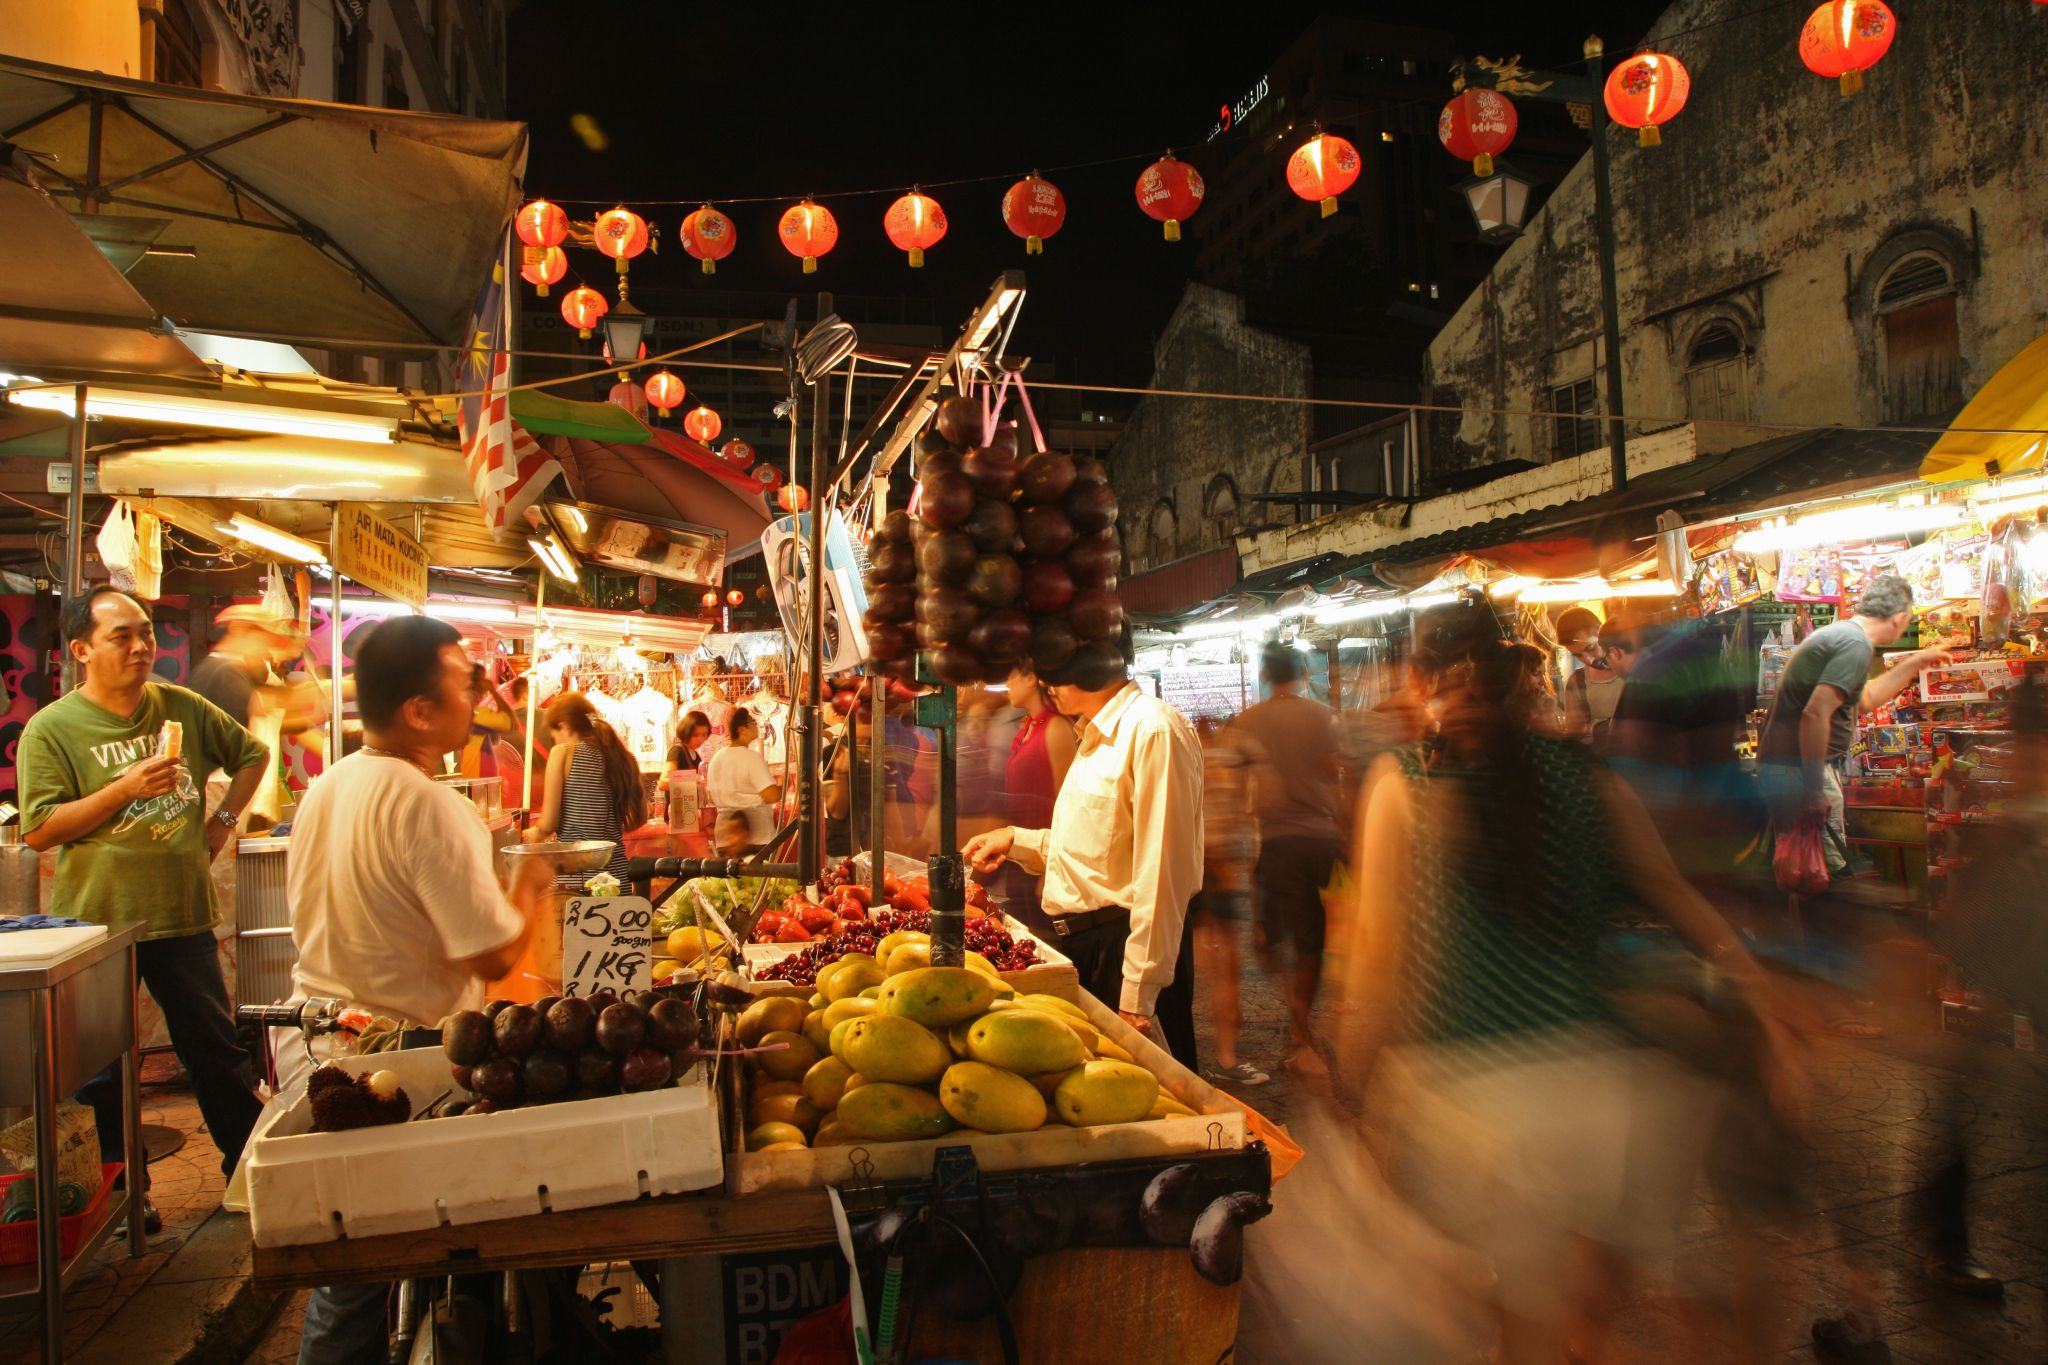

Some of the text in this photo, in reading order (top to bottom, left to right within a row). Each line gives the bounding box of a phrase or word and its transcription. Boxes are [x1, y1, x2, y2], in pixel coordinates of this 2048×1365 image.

[356, 510, 372, 534] AIR
[374, 521, 396, 550] MATA
[399, 537, 424, 567] KUCING
[1981, 667, 2010, 677] FLIER
[90, 733, 161, 768] VINTA
[163, 793, 180, 809] FAS
[580, 902, 651, 938] 5.00
[611, 935, 651, 949] 500gm
[573, 950, 646, 986] 1 KG
[735, 1259, 836, 1314] BDM
